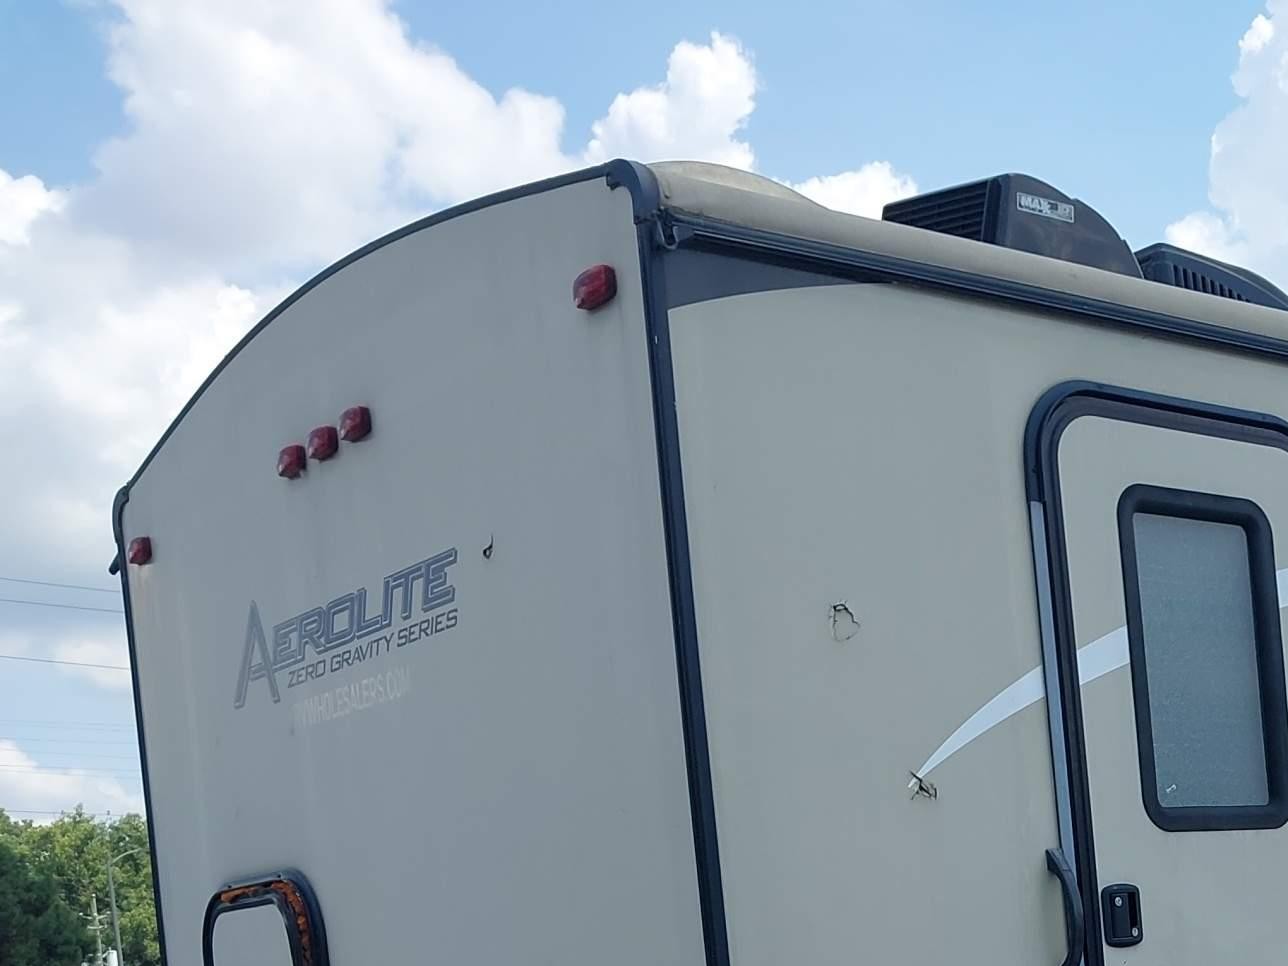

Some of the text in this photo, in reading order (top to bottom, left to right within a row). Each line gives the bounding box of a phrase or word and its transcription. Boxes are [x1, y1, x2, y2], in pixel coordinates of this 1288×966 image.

[234, 547, 458, 710] AEROLITE
[288, 608, 458, 688] ZERO GRAVITY SERIES
